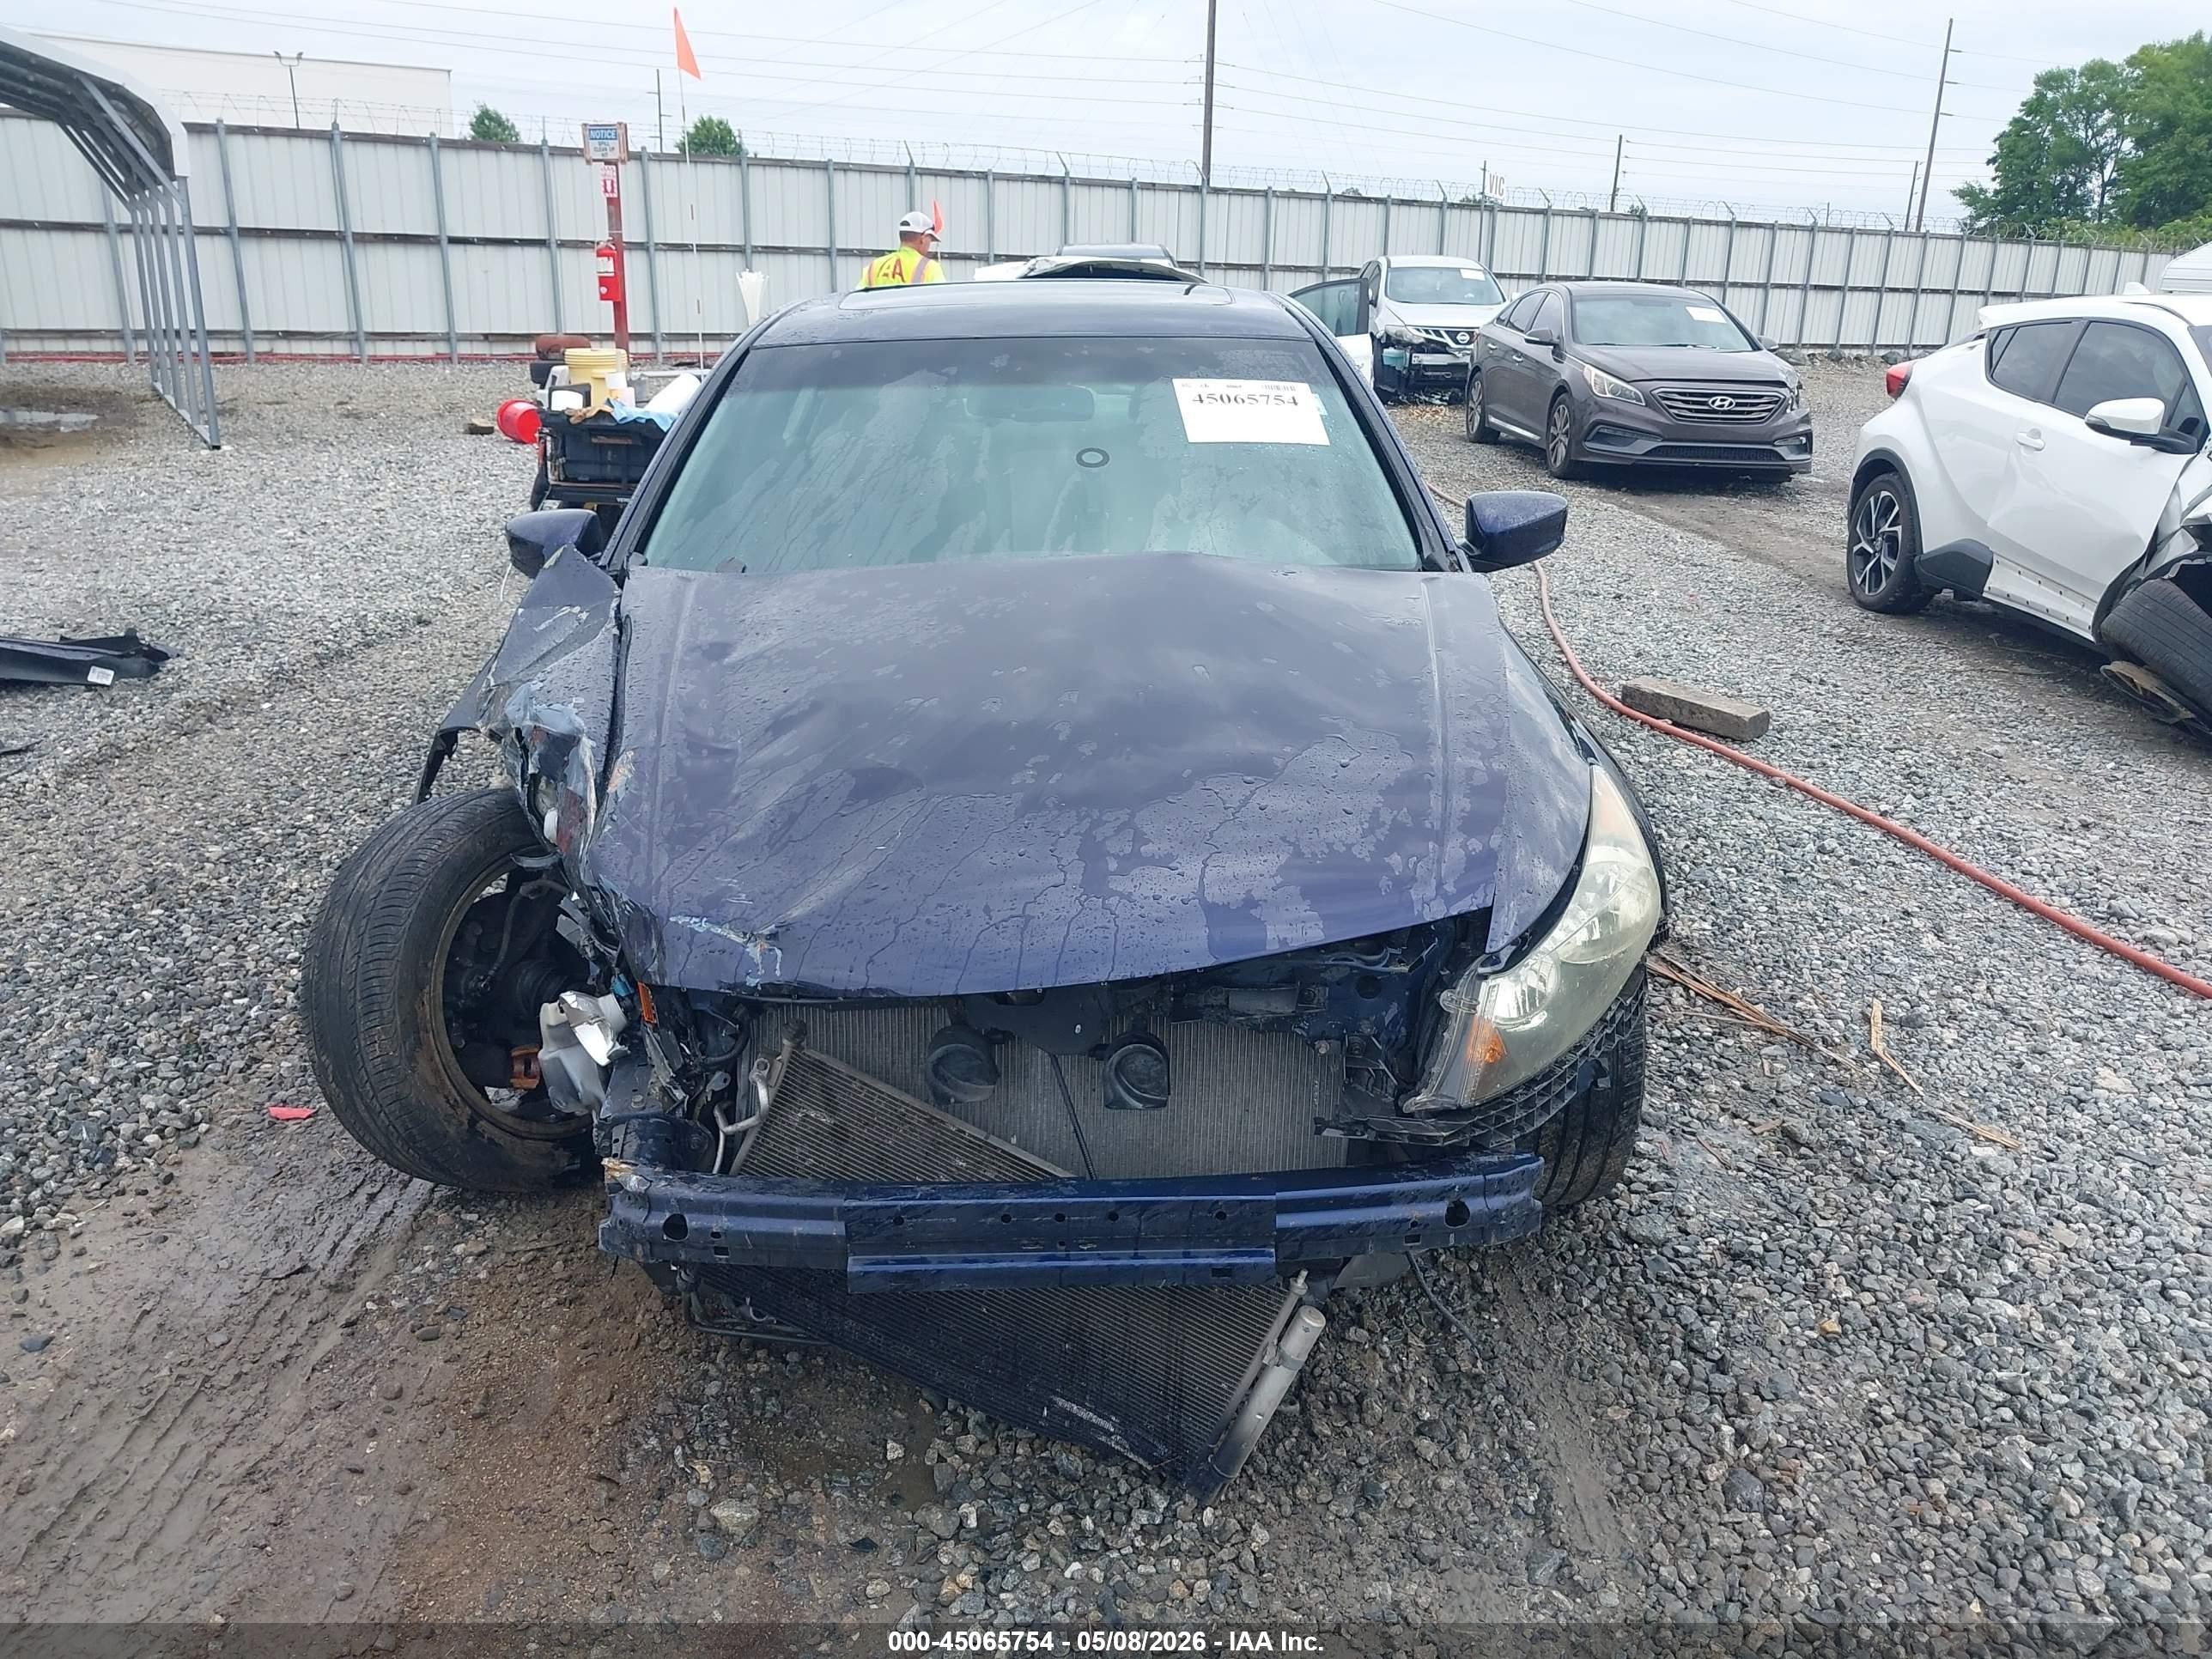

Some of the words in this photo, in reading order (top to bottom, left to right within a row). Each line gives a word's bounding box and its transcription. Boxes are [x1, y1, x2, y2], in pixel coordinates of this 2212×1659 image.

[590, 130, 617, 139] NOTICE
[1489, 173, 1505, 197] VIC
[1192, 392, 1299, 406] 45065754
